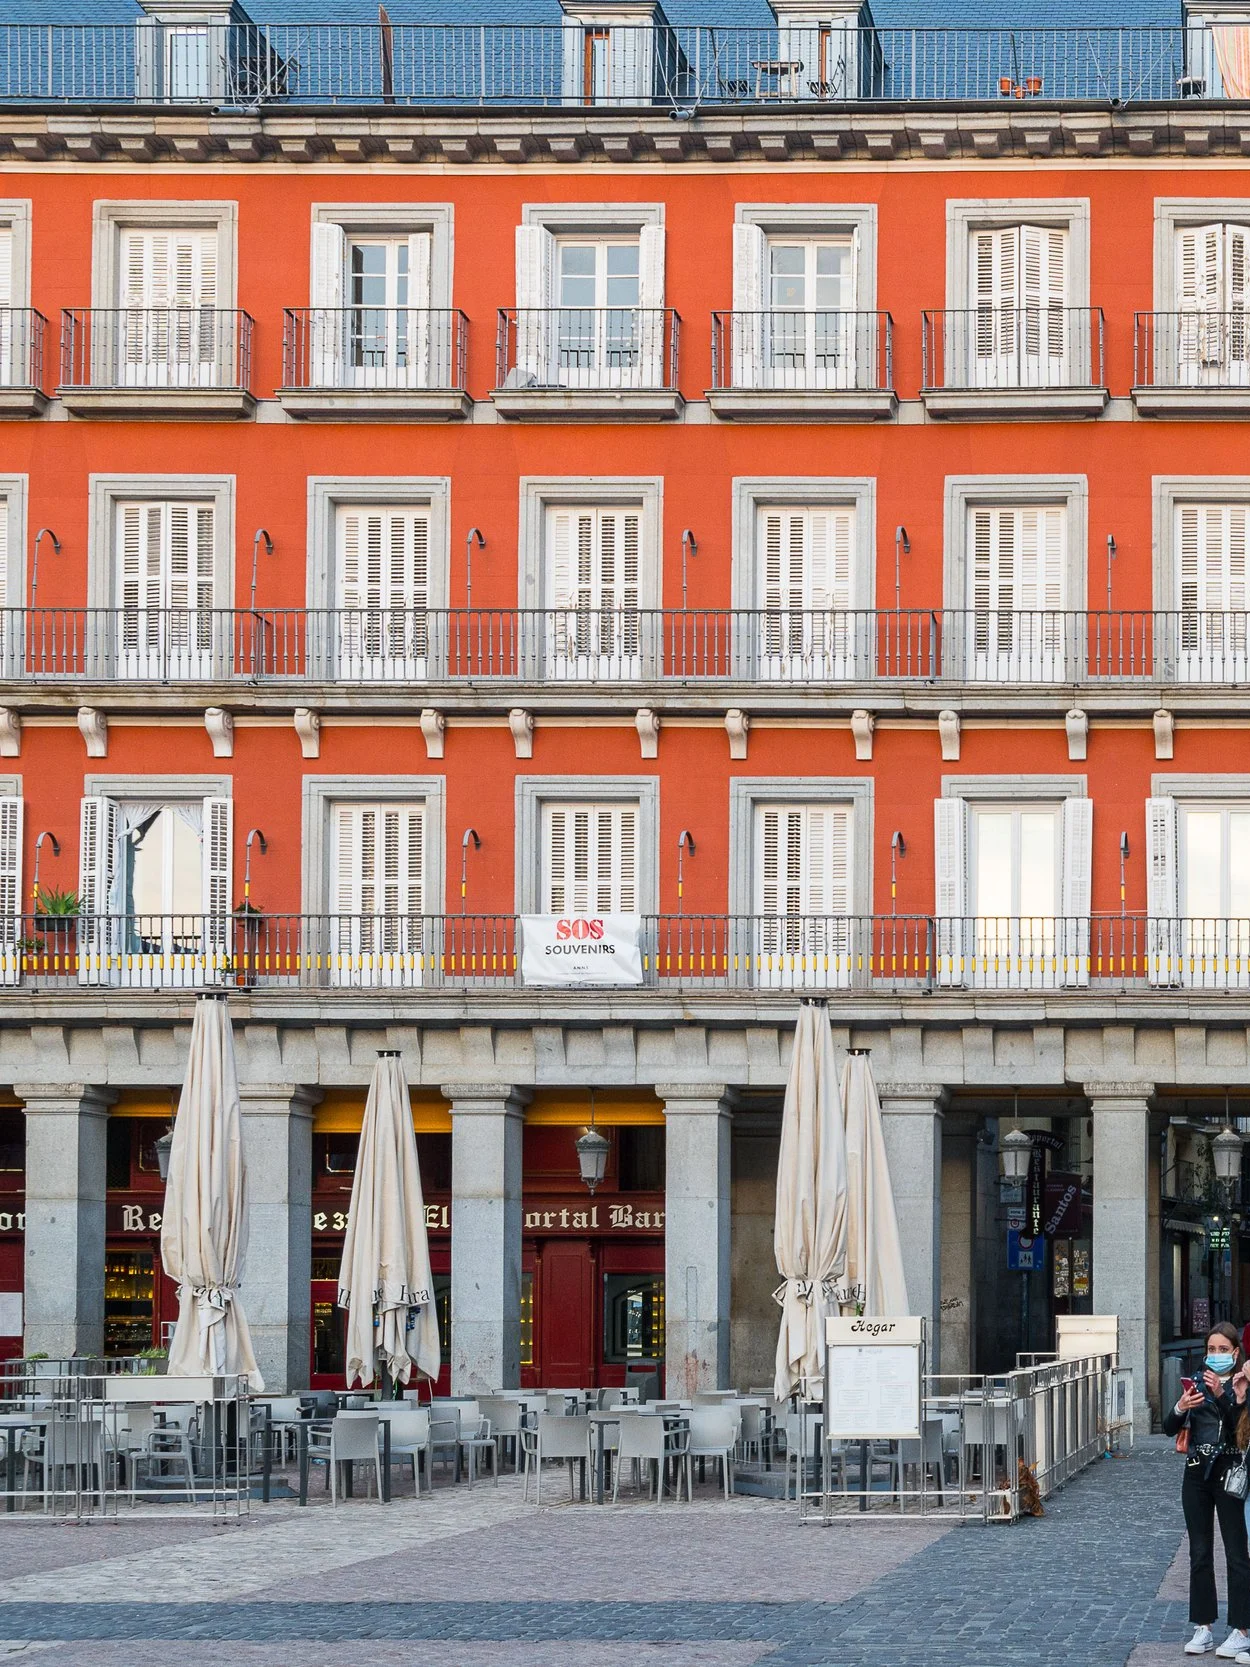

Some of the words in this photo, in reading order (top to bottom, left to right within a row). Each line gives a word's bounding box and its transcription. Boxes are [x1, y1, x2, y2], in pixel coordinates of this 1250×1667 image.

[556, 919, 604, 940] SOS
[545, 945, 615, 955] SOUVENIRS
[608, 1204, 665, 1228] Bar
[1044, 1185, 1077, 1234] Santos
[851, 1320, 896, 1337] Hegar
